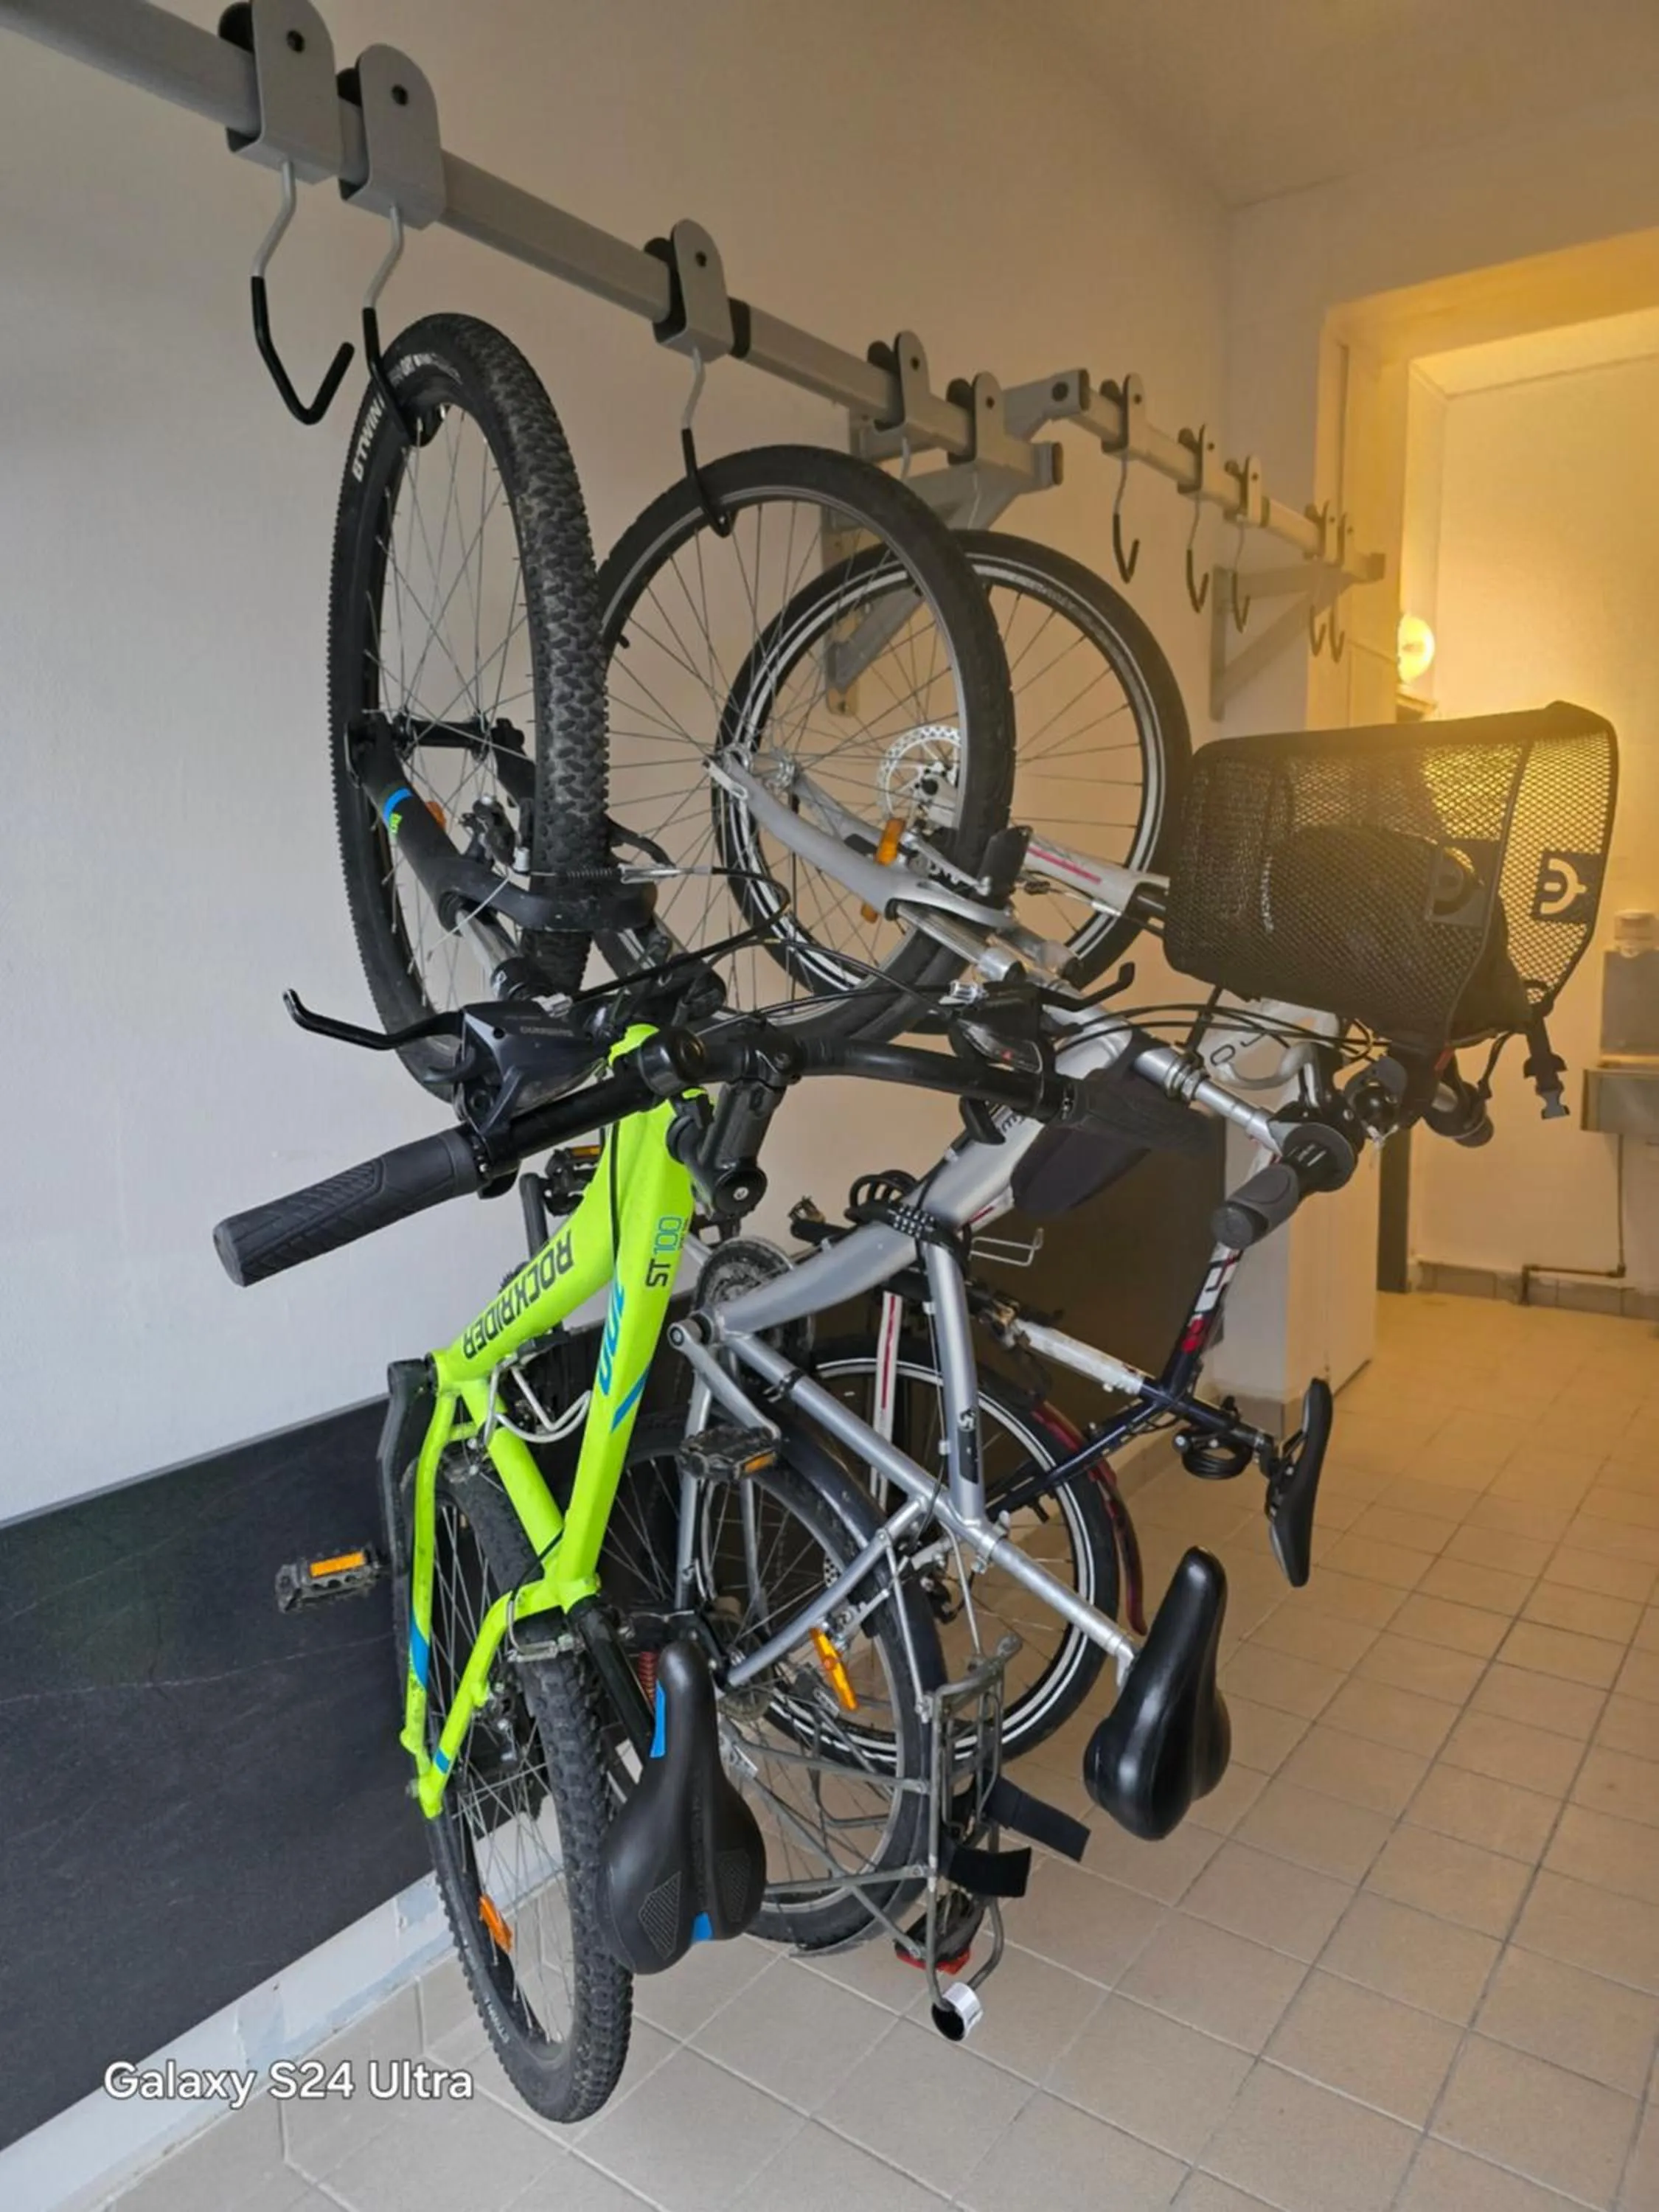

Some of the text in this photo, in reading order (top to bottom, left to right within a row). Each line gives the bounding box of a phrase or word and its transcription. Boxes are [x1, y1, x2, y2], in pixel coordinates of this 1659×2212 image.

[462, 1230, 574, 1359] ROCKRIDER
[646, 1216, 683, 1287] ST 100
